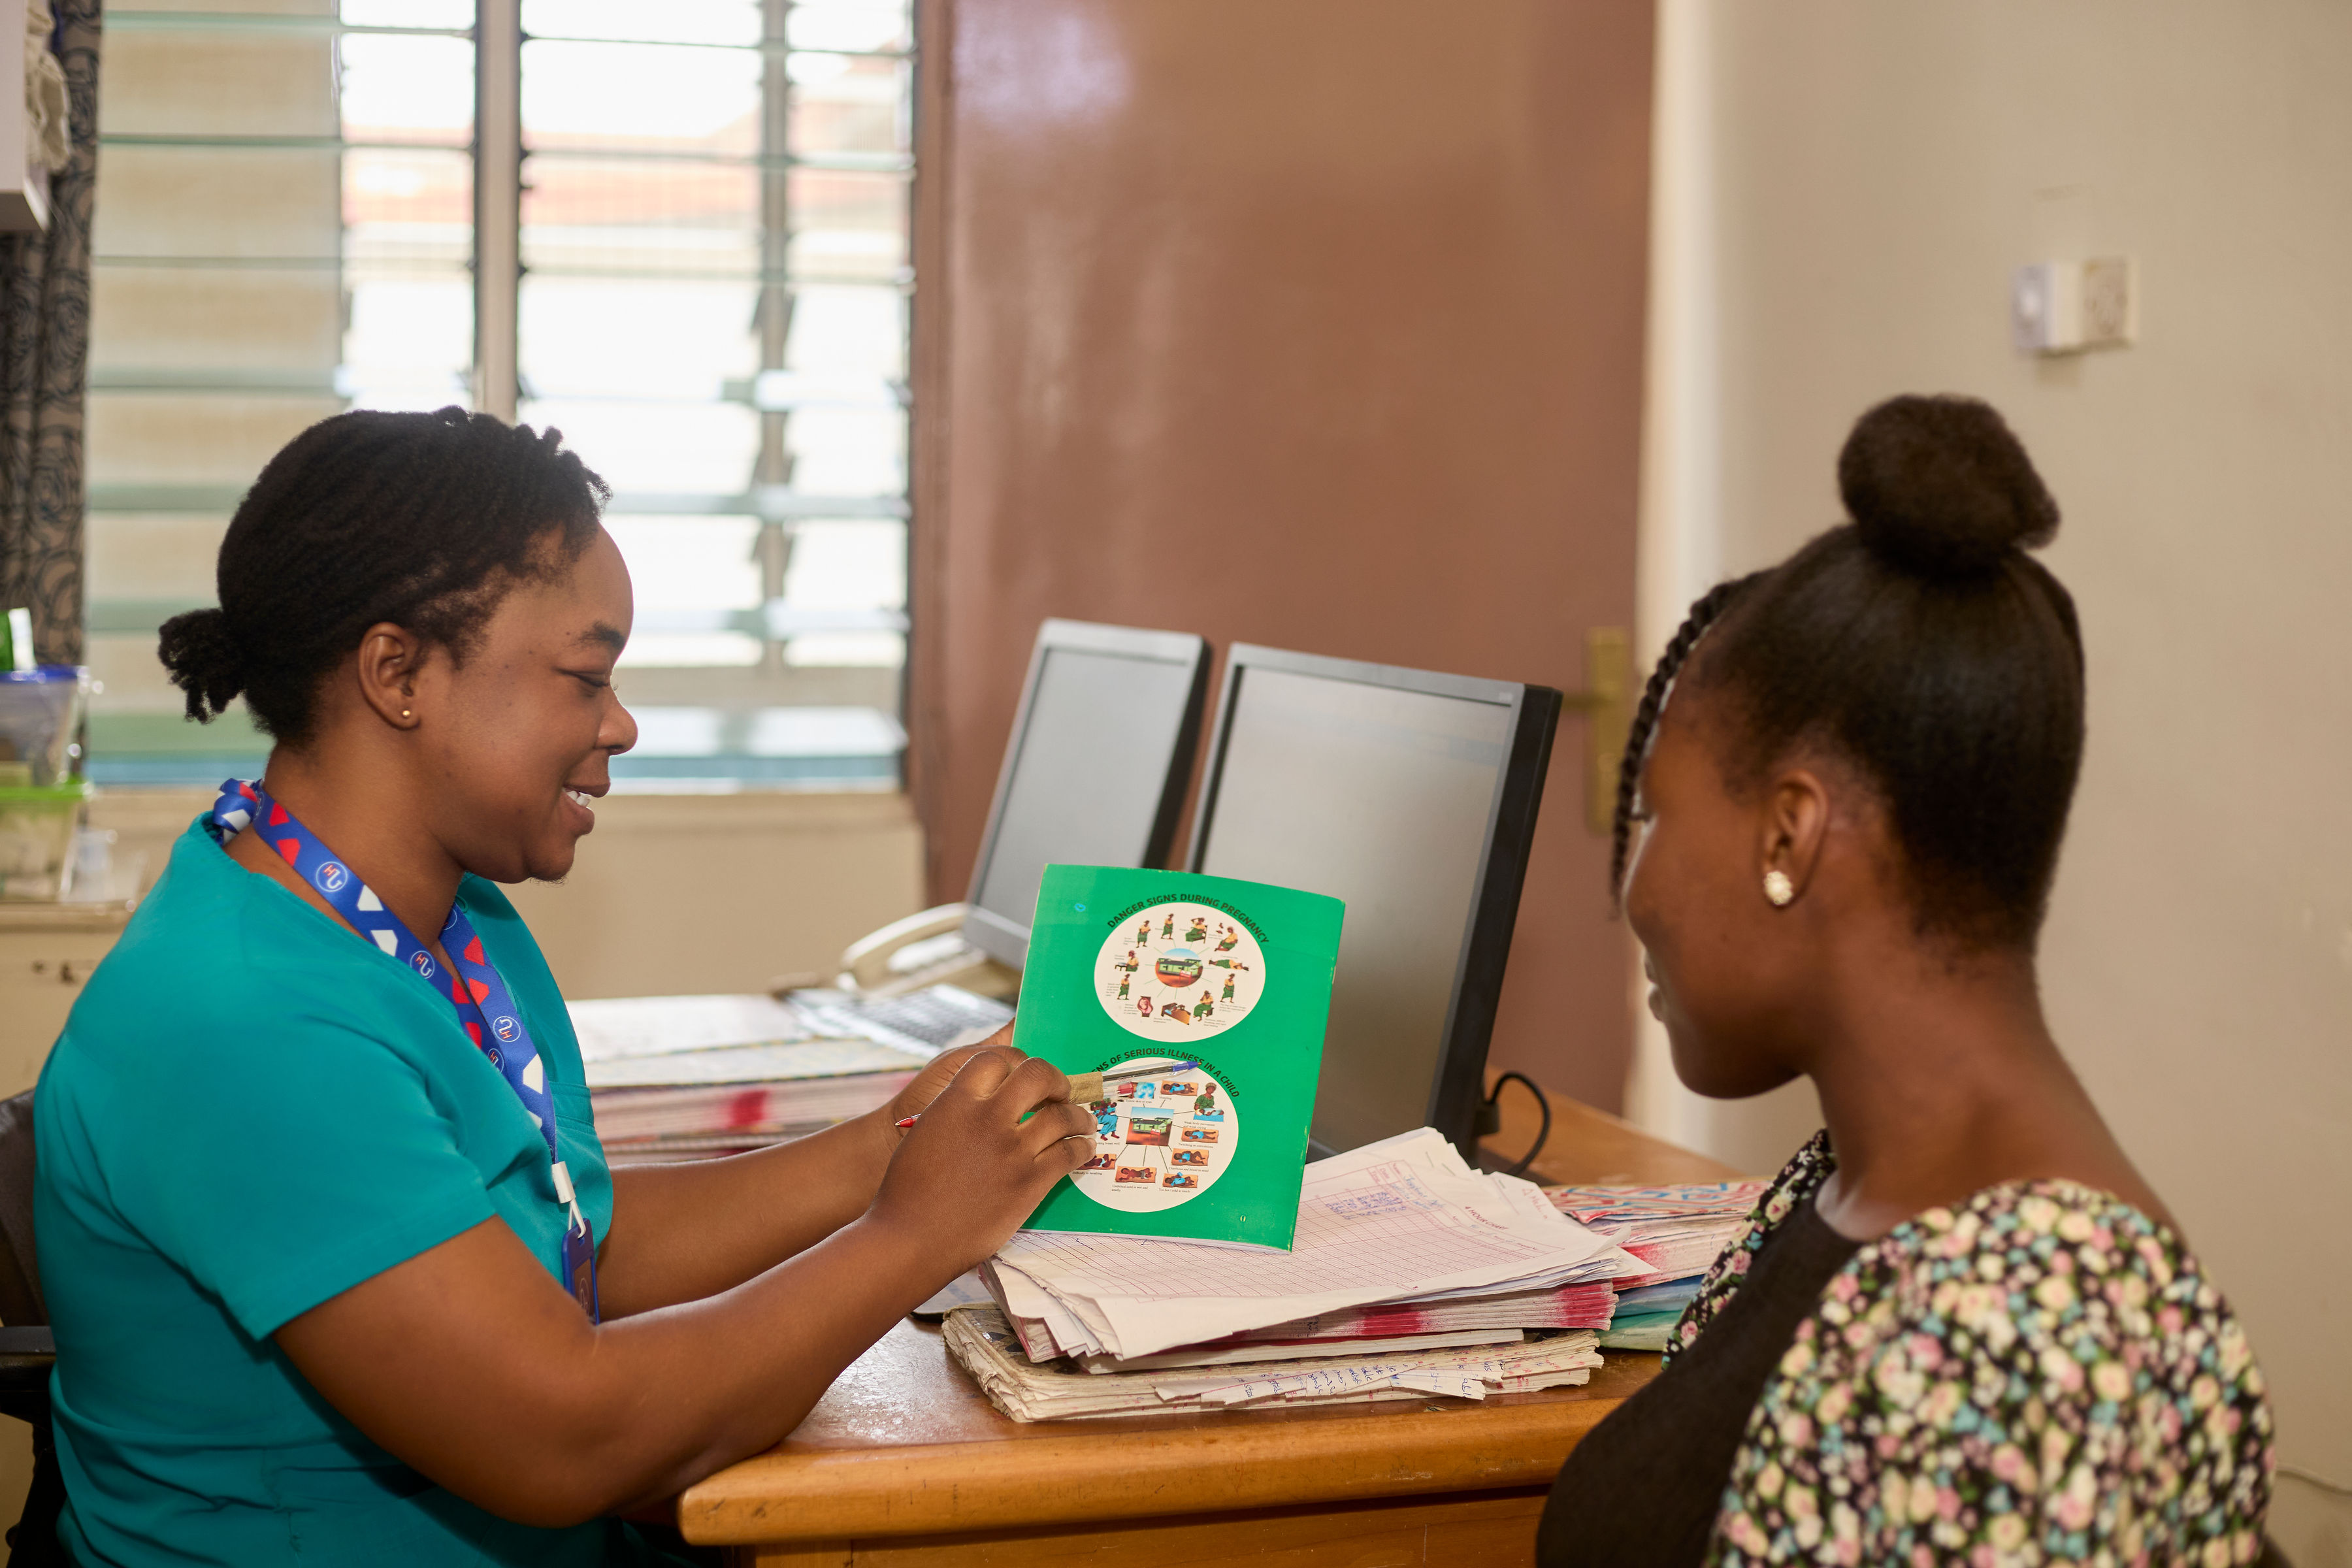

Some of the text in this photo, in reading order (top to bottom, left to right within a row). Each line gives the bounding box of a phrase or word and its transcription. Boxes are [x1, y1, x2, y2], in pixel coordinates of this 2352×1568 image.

[1107, 894, 1269, 943] DANGER SIGNS DURING PREGNANCY
[1110, 1054, 1122, 1064] OF
[1124, 1048, 1165, 1058] SERIOUS
[1168, 1049, 1204, 1065] ILLNESS
[1204, 1062, 1215, 1073] IN
[1221, 1075, 1239, 1098] CHILD
